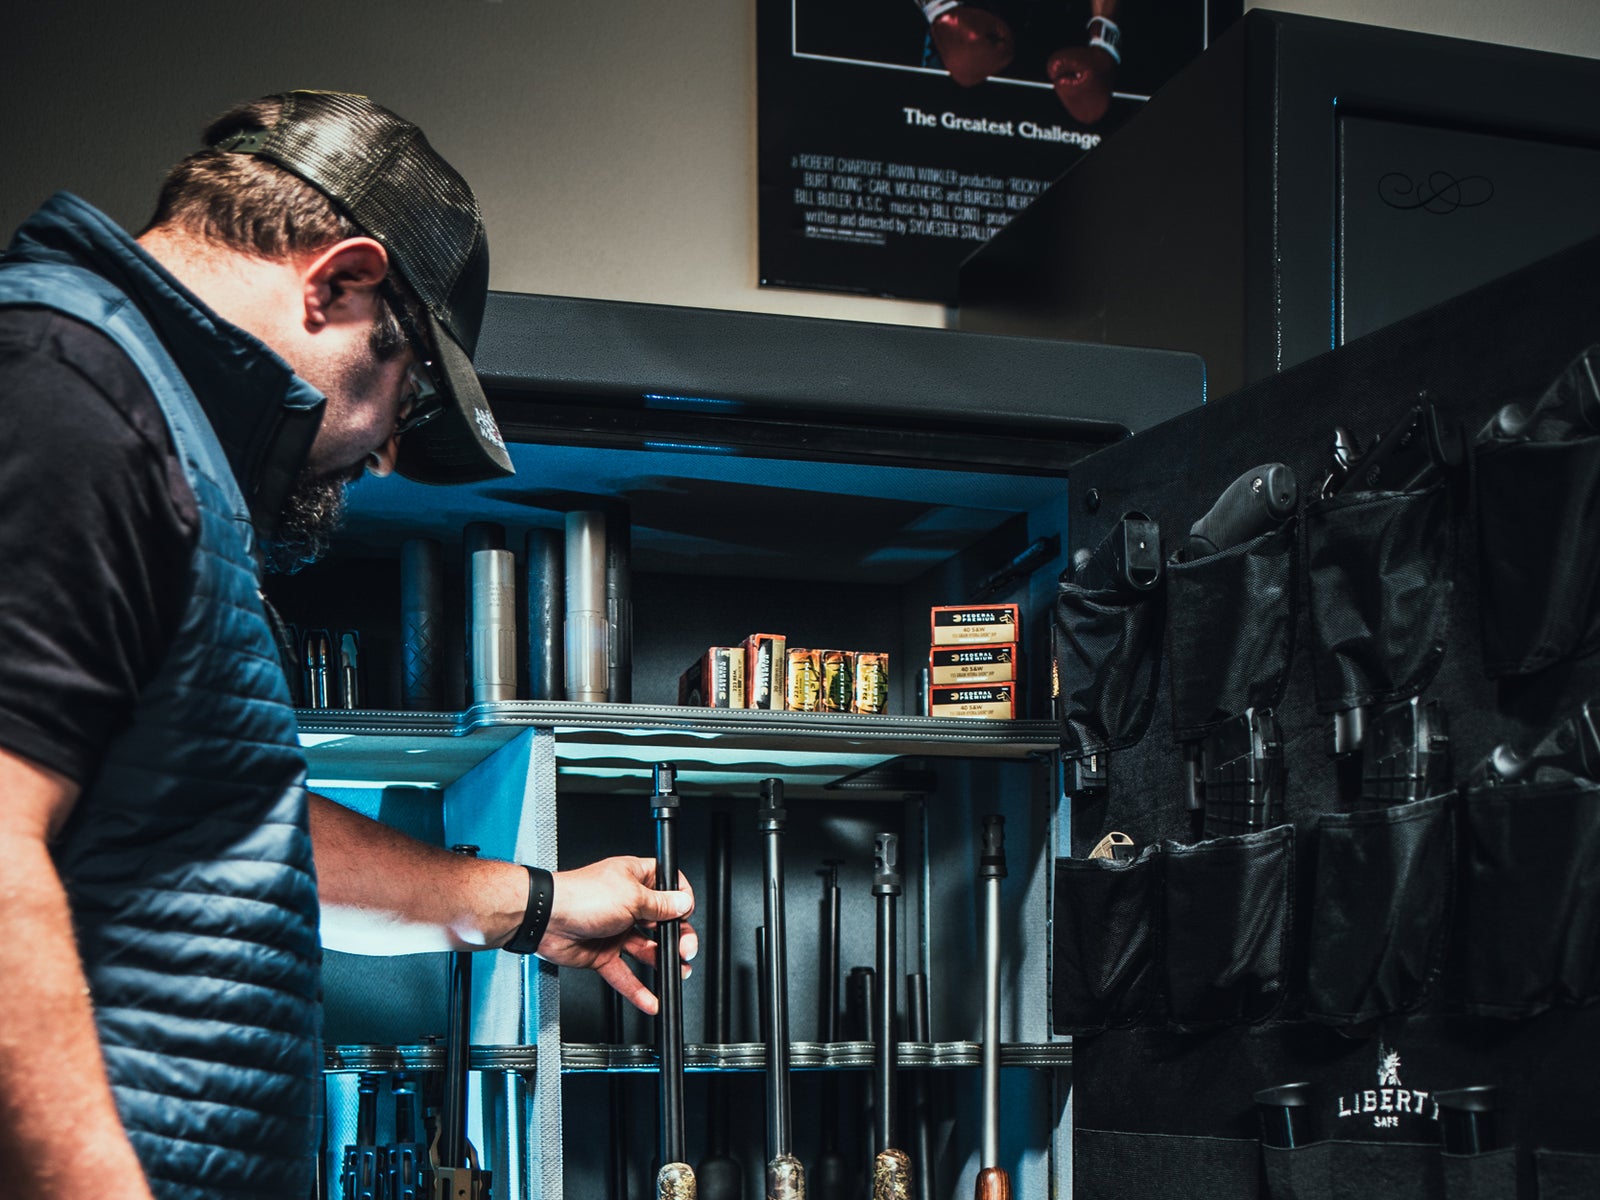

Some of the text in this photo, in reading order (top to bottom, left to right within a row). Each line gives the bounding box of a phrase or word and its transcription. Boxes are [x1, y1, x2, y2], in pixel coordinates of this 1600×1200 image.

[903, 107, 937, 127] The
[941, 112, 1014, 136] Greatest
[799, 154, 834, 171] ROBERT
[917, 166, 958, 185] WINKLER
[959, 173, 1004, 189] production
[803, 171, 828, 188] BURT
[831, 174, 862, 192] YOUNG
[869, 178, 892, 195] CARL
[894, 181, 944, 202] WEATHERS
[946, 190, 962, 202] and
[964, 185, 1004, 207] BURGESS
[794, 188, 814, 205] BILL
[889, 201, 917, 216] music
[919, 203, 930, 218] by
[931, 203, 950, 218] BILL
[953, 205, 980, 222] CONTI
[805, 210, 838, 225] written
[840, 212, 856, 227] and
[857, 213, 894, 232] directed
[895, 217, 907, 235] by
[909, 219, 959, 238] SYLVESTER
[1373, 1116, 1400, 1128] SAFE
